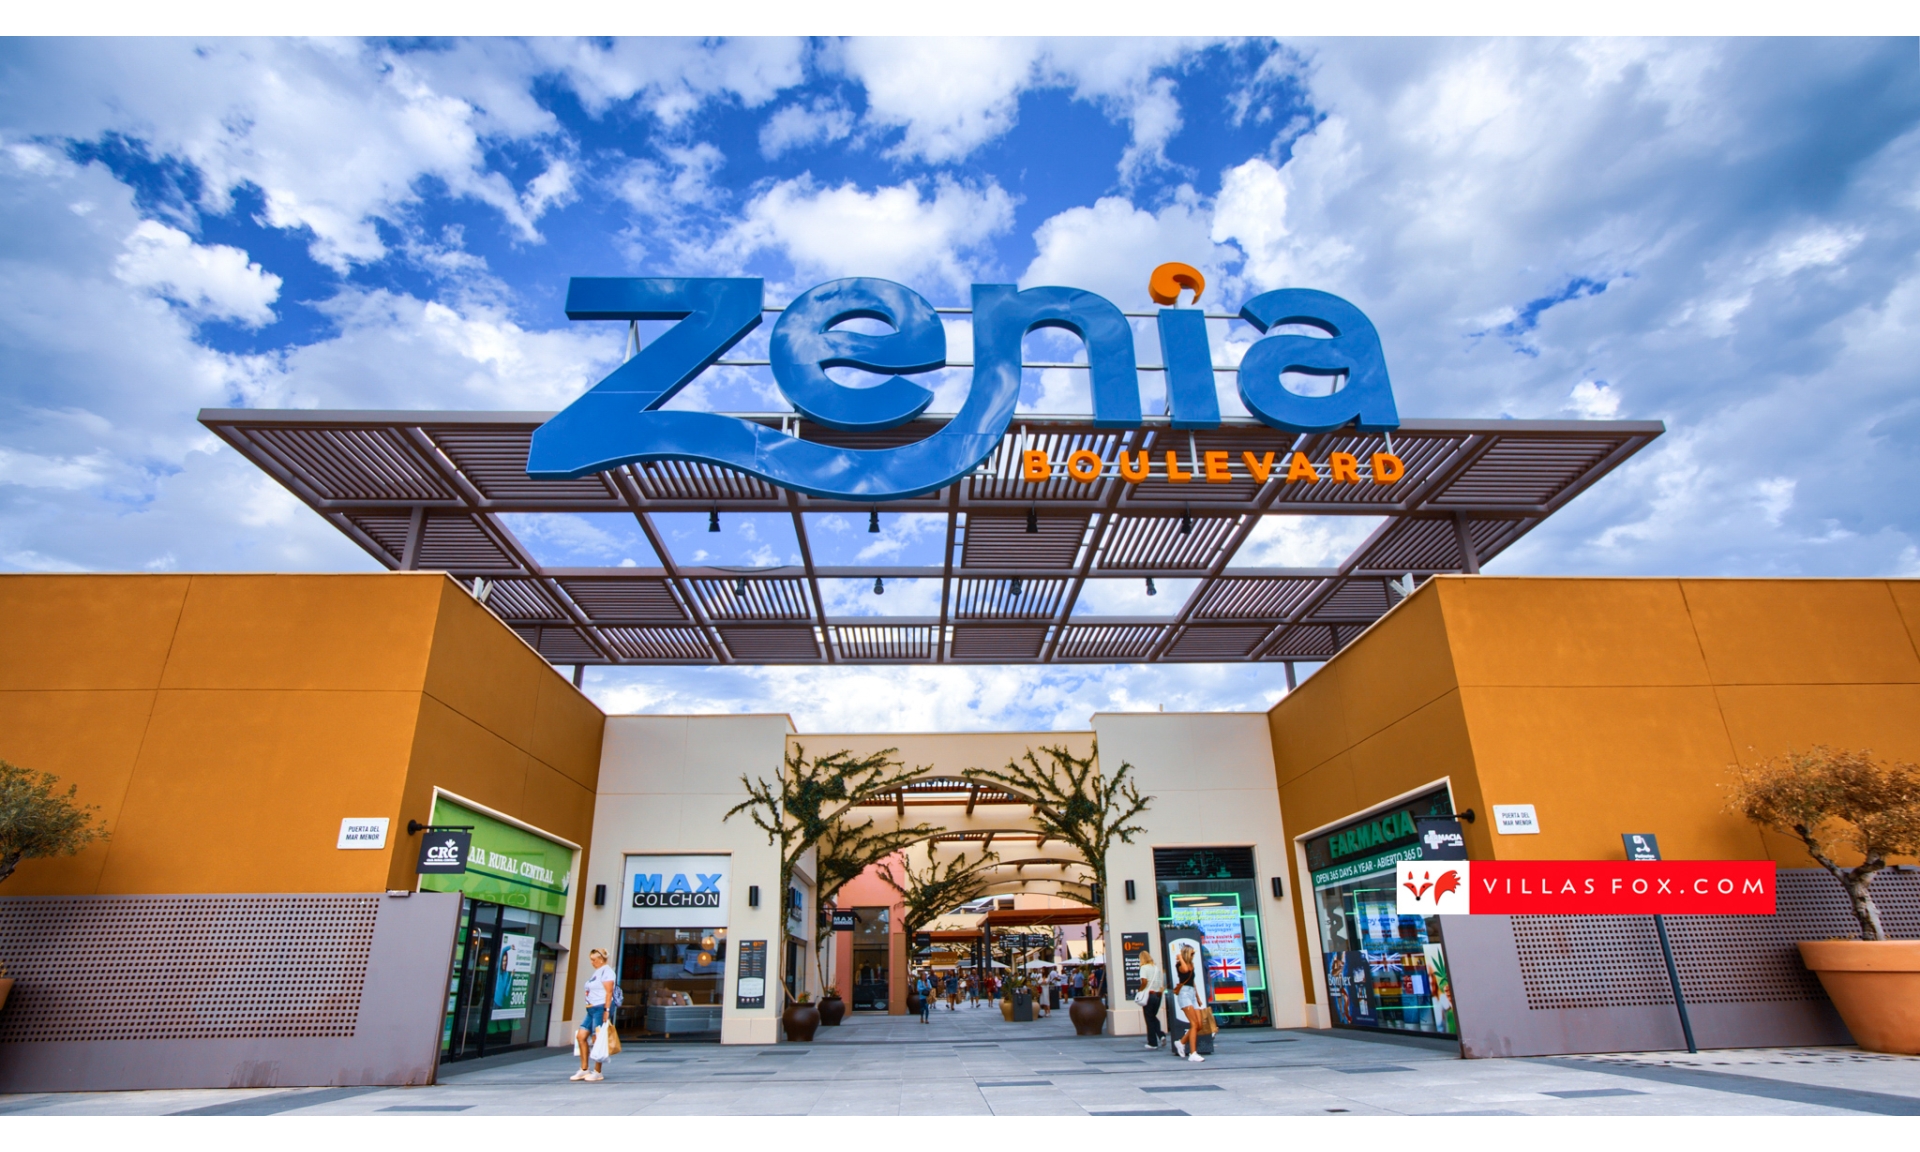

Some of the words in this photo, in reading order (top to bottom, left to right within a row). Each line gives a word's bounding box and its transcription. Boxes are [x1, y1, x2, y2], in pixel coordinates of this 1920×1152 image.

[1023, 450, 1404, 485] BOULEVARD
[1329, 810, 1418, 859] FARMACIA
[427, 846, 459, 859] CRC
[467, 846, 486, 866] AJA
[488, 851, 518, 874] RURAL
[520, 861, 554, 885] CENTRAL
[1315, 870, 1330, 884] OPEN
[1329, 868, 1339, 880] 365
[1339, 865, 1353, 879] DAYS
[1353, 864, 1359, 875] A
[1359, 861, 1373, 873] YEAR
[1377, 852, 1403, 868] ABIERTO
[1403, 848, 1416, 861] 365
[1416, 847, 1423, 858] D
[633, 873, 722, 893] MAX
[634, 893, 718, 906] COLCHON
[510, 992, 527, 1005] 300€
